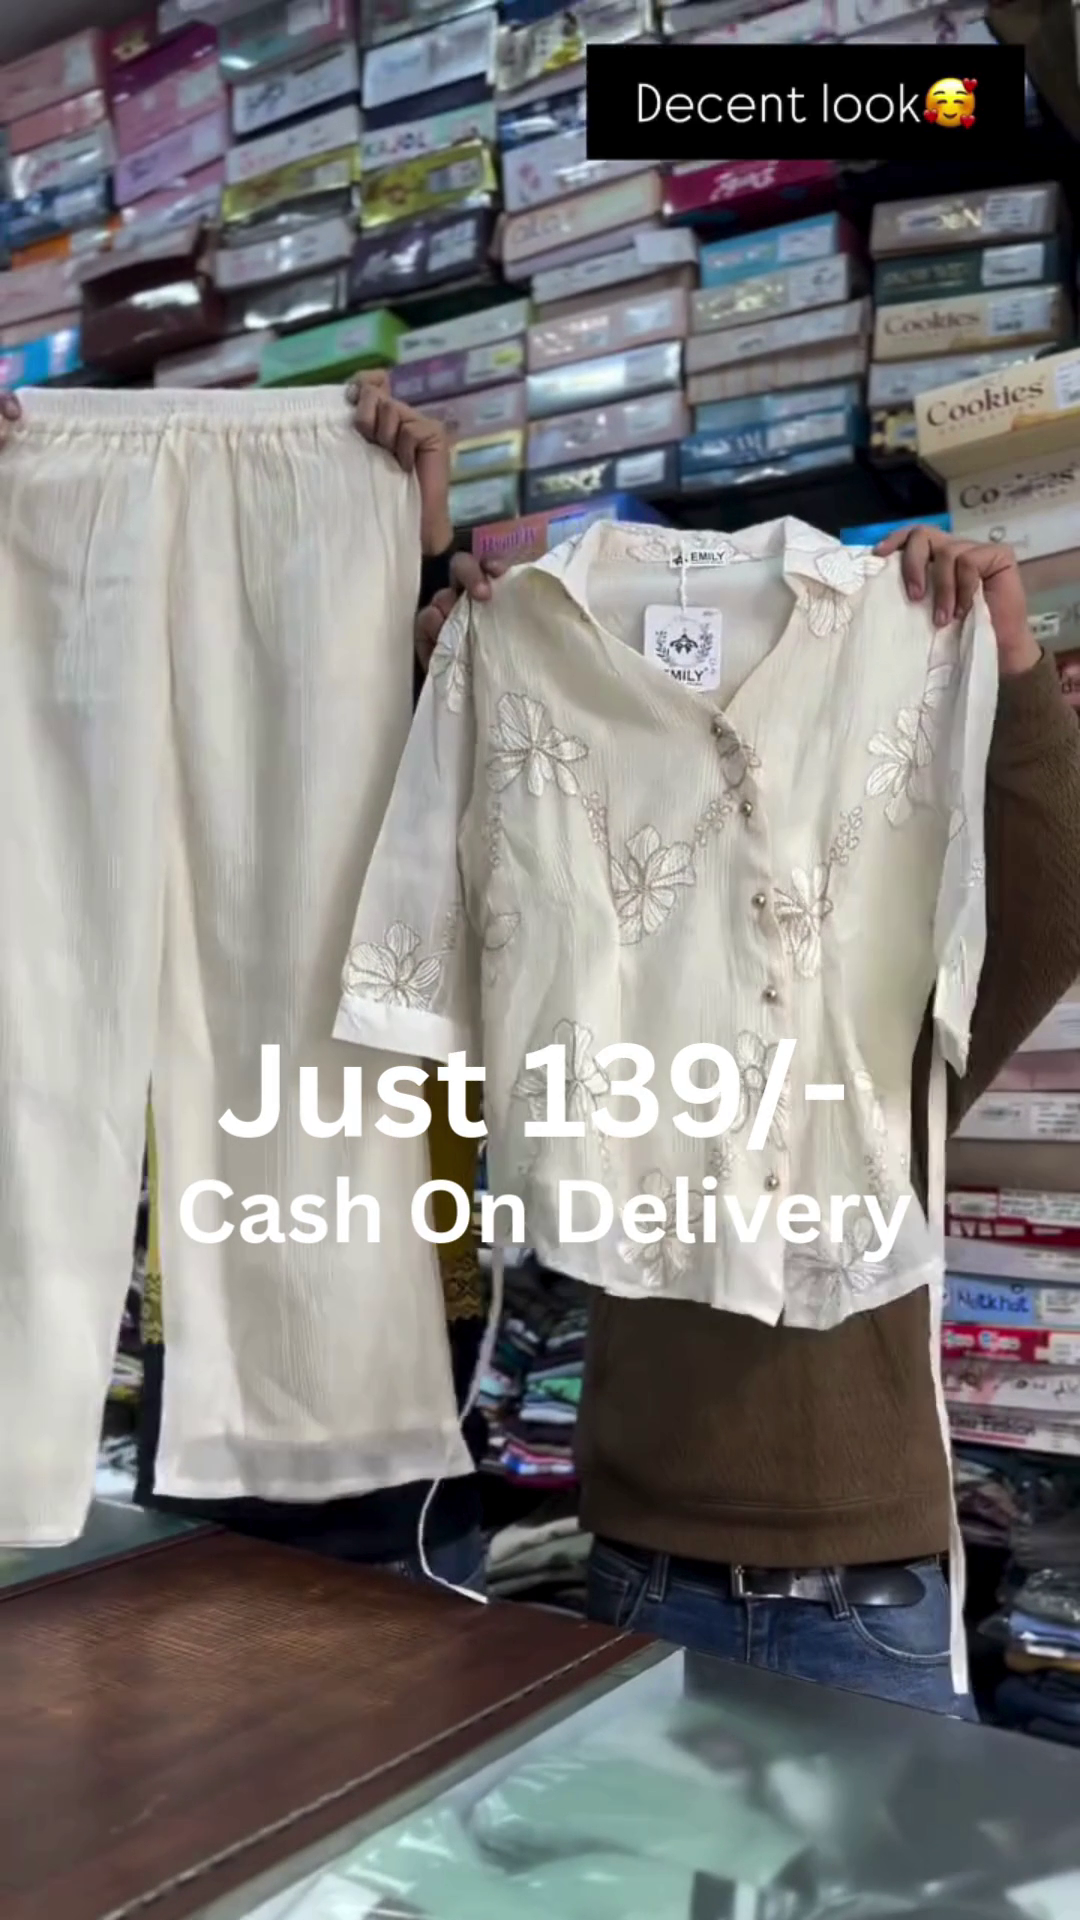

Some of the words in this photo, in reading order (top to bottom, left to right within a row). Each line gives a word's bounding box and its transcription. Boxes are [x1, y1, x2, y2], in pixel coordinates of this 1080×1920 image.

[884, 310, 980, 337] Cookies
[926, 381, 1044, 427] Cookies
[690, 551, 725, 562] EMILY
[665, 668, 705, 683] MILY
